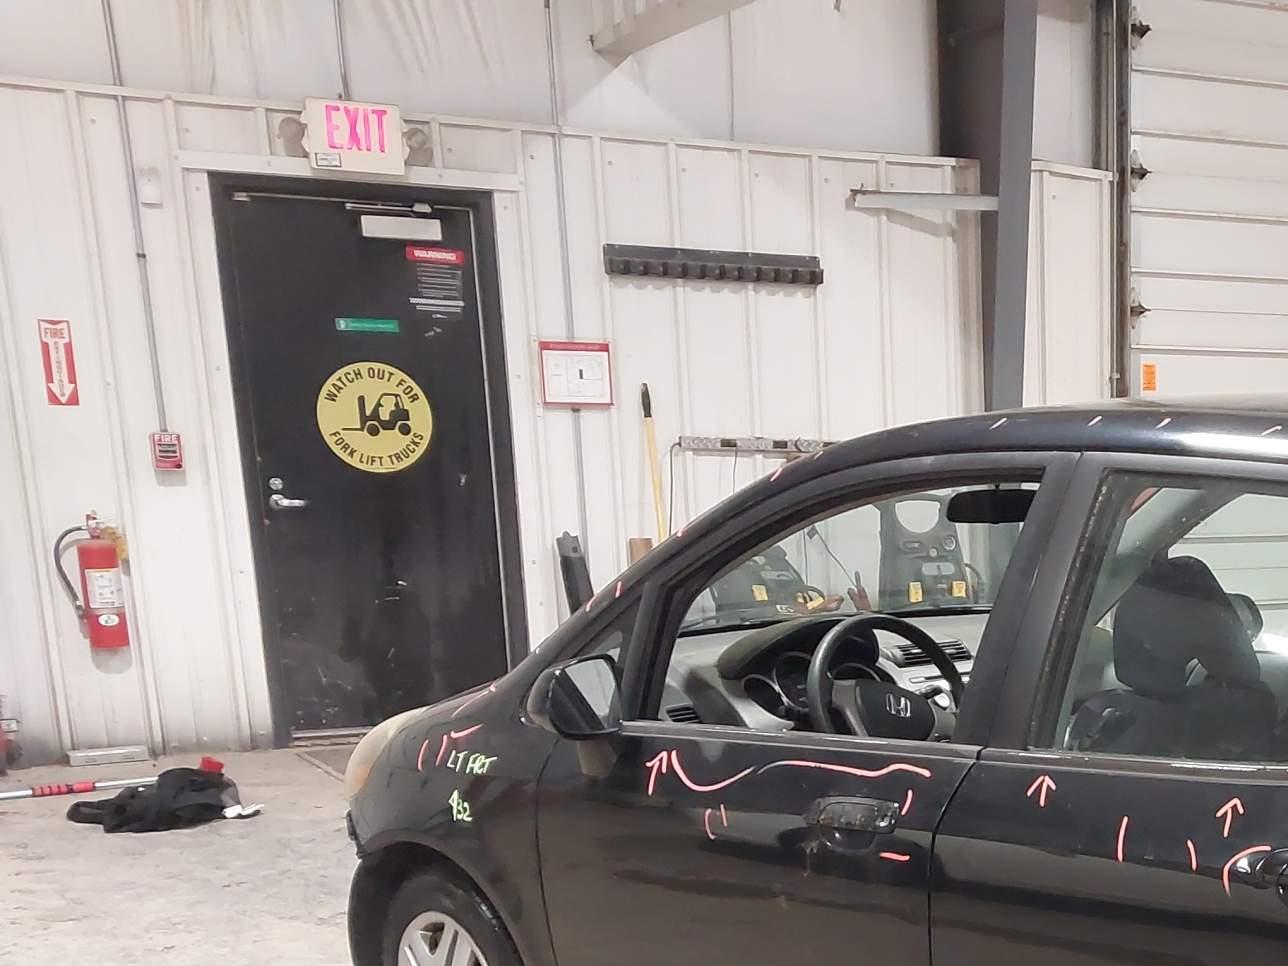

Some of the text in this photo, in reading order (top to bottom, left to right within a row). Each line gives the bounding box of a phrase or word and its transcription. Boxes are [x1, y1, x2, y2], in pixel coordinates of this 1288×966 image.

[325, 104, 388, 153] EXIT
[44, 327, 66, 340] FIRE
[324, 366, 421, 404] WATCH OUT FOR
[154, 434, 179, 444] FIRE
[329, 430, 425, 467] FORK LIFT TRUCKS
[446, 749, 469, 772] LT
